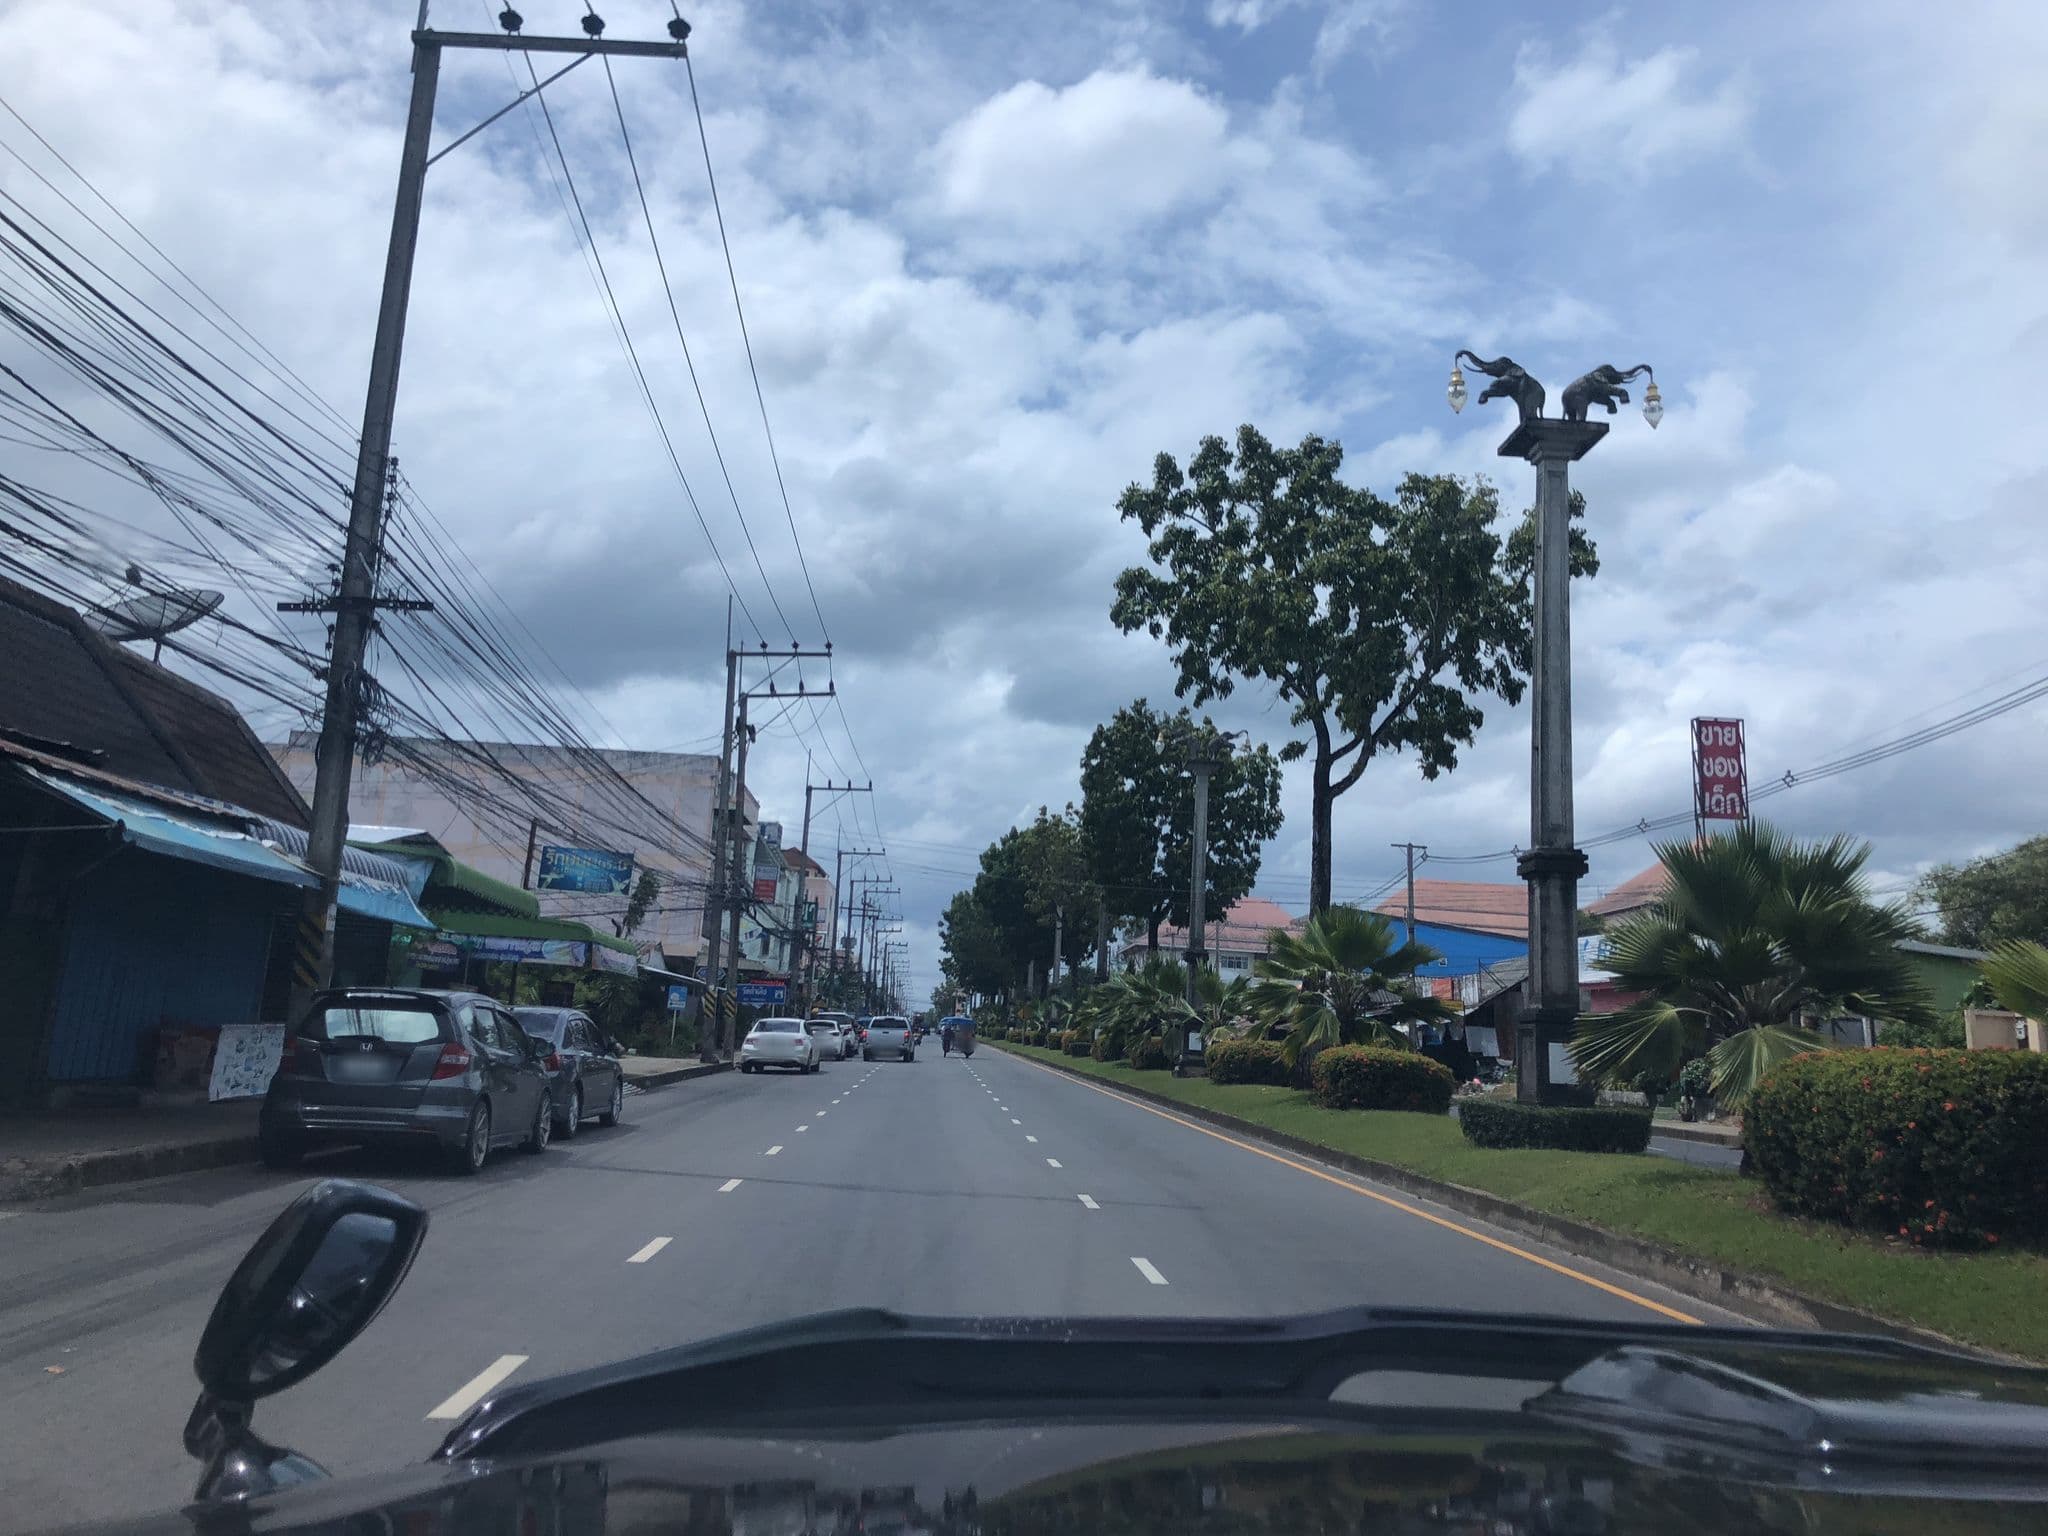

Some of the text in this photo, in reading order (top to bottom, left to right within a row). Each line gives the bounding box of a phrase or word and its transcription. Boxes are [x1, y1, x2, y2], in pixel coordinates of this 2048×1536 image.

[1701, 726, 1736, 746] ขาย
[1703, 756, 1739, 778] ของ
[1705, 784, 1741, 814] เด็ก
